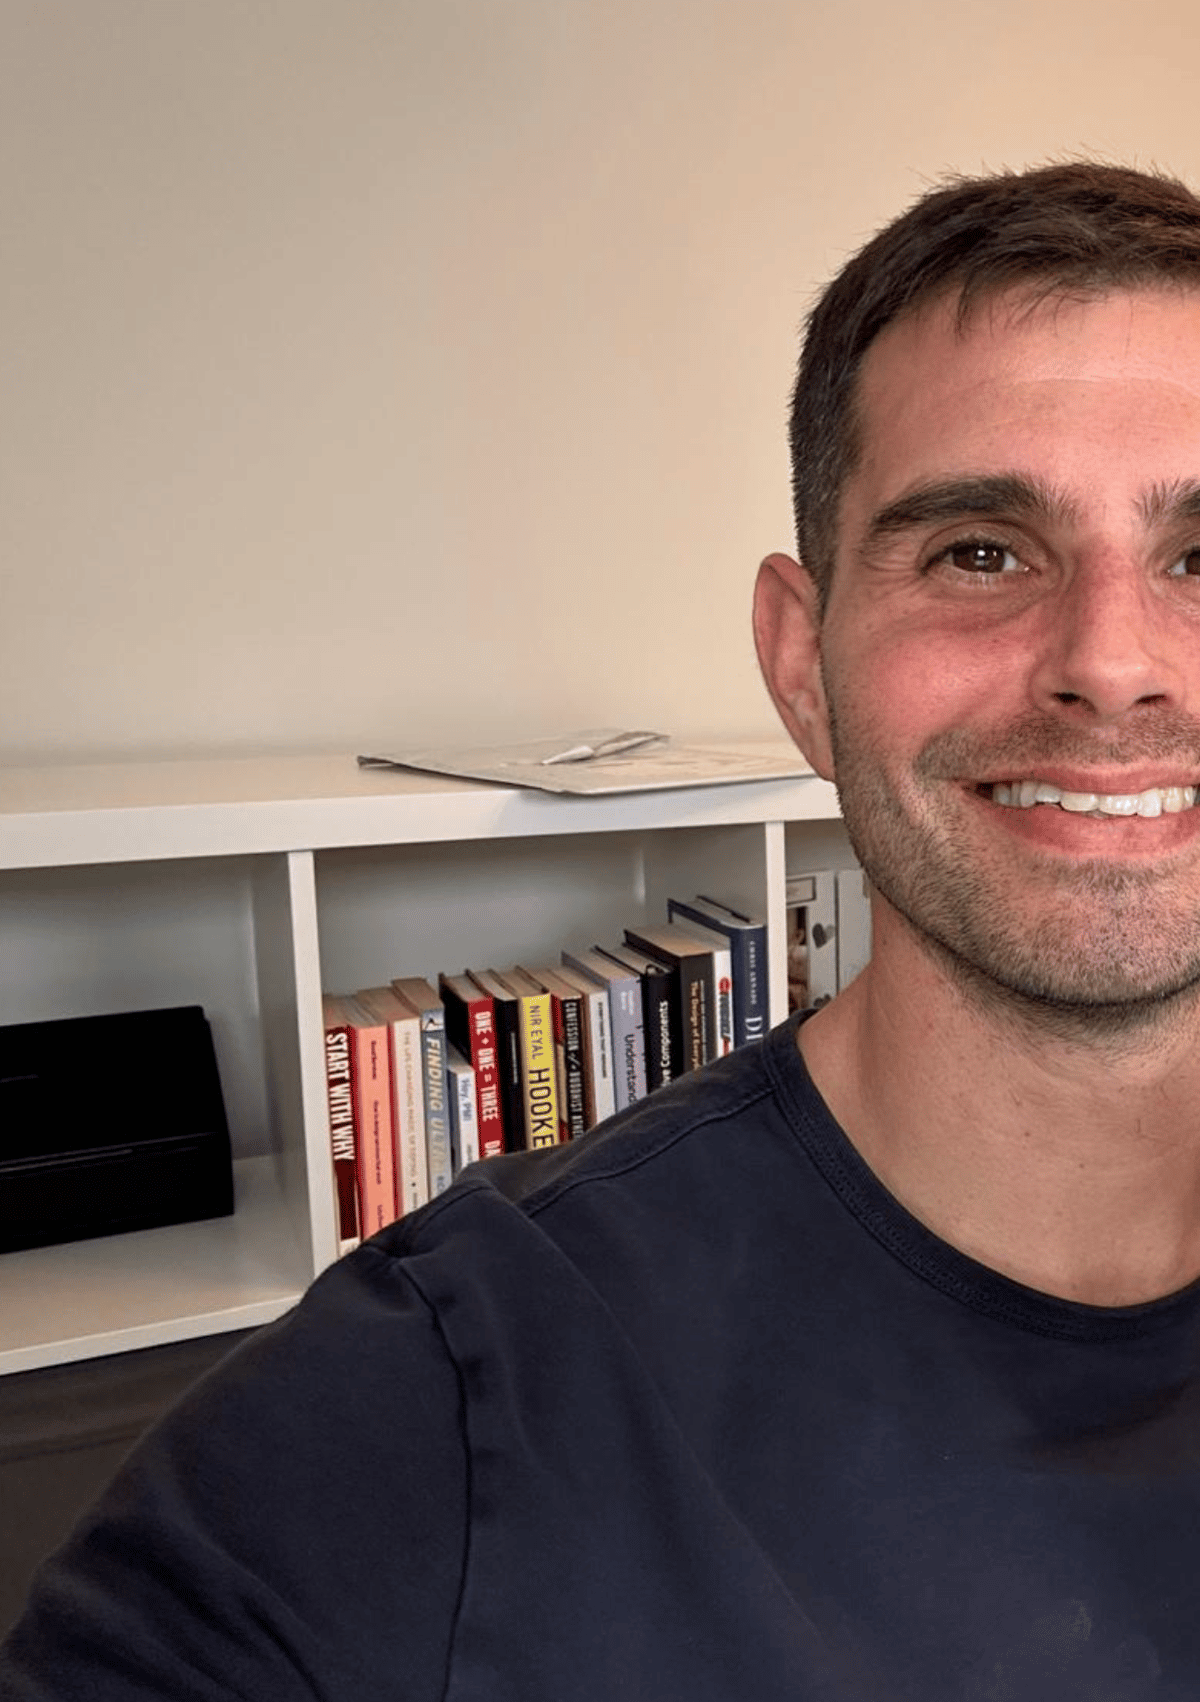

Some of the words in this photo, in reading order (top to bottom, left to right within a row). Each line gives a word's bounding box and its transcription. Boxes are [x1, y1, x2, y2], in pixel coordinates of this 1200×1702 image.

[476, 1010, 492, 1036] ONE
[529, 1005, 541, 1026] NIR
[565, 1001, 579, 1051] CONFESSION
[659, 1000, 672, 1068] Components
[745, 1015, 764, 1041] DI
[326, 1032, 349, 1080] START
[478, 1047, 495, 1072] ONE
[531, 1030, 544, 1060] EYAL
[426, 1037, 444, 1111] FINDING
[624, 1033, 638, 1104] Understand
[328, 1081, 352, 1124] WITH
[481, 1083, 498, 1122] THREE
[529, 1067, 555, 1148] HOOKE
[331, 1124, 355, 1161] WHY
[484, 1139, 501, 1158] DA
